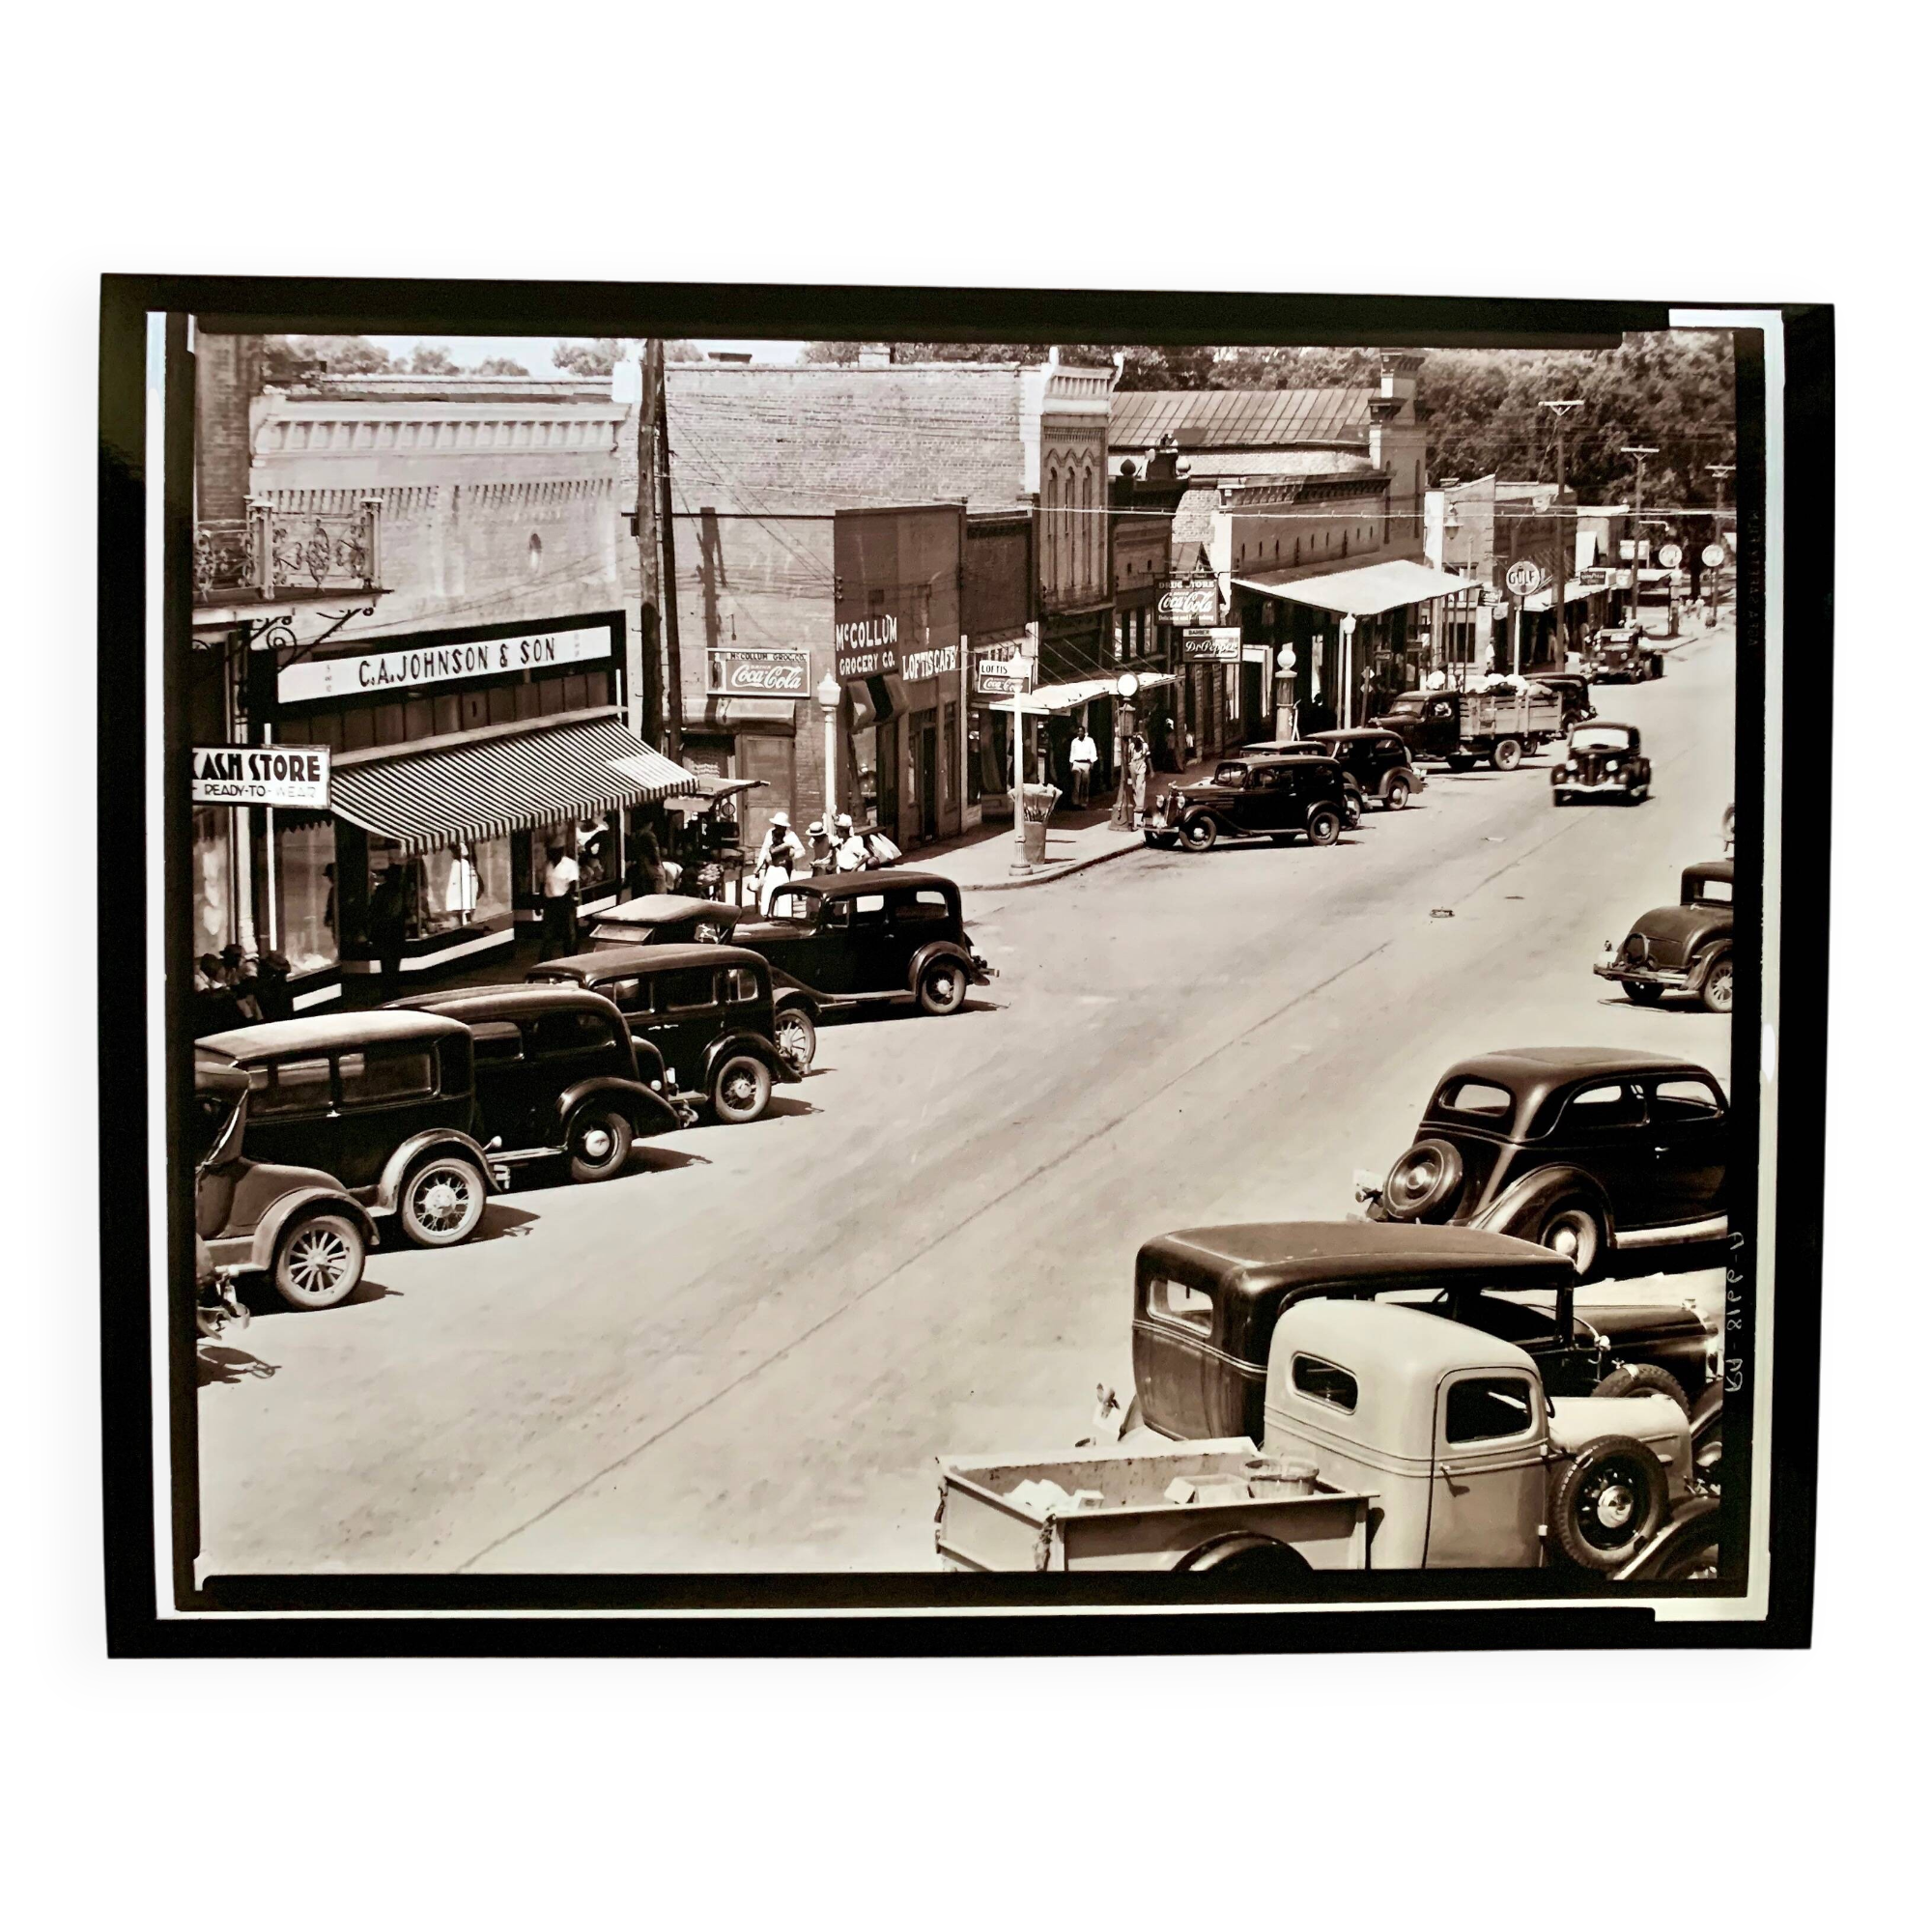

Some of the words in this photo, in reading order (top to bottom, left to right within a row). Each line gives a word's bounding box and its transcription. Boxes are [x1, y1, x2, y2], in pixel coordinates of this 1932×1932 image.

[1158, 590, 1215, 614] Coca-Cola
[499, 642, 510, 668] &
[520, 638, 555, 663] SON
[839, 653, 879, 676] GROCERY
[882, 650, 895, 669] CO.
[731, 664, 804, 690] Coca-Cola
[981, 665, 1009, 674] LOFTIS
[248, 753, 321, 781] STORE
